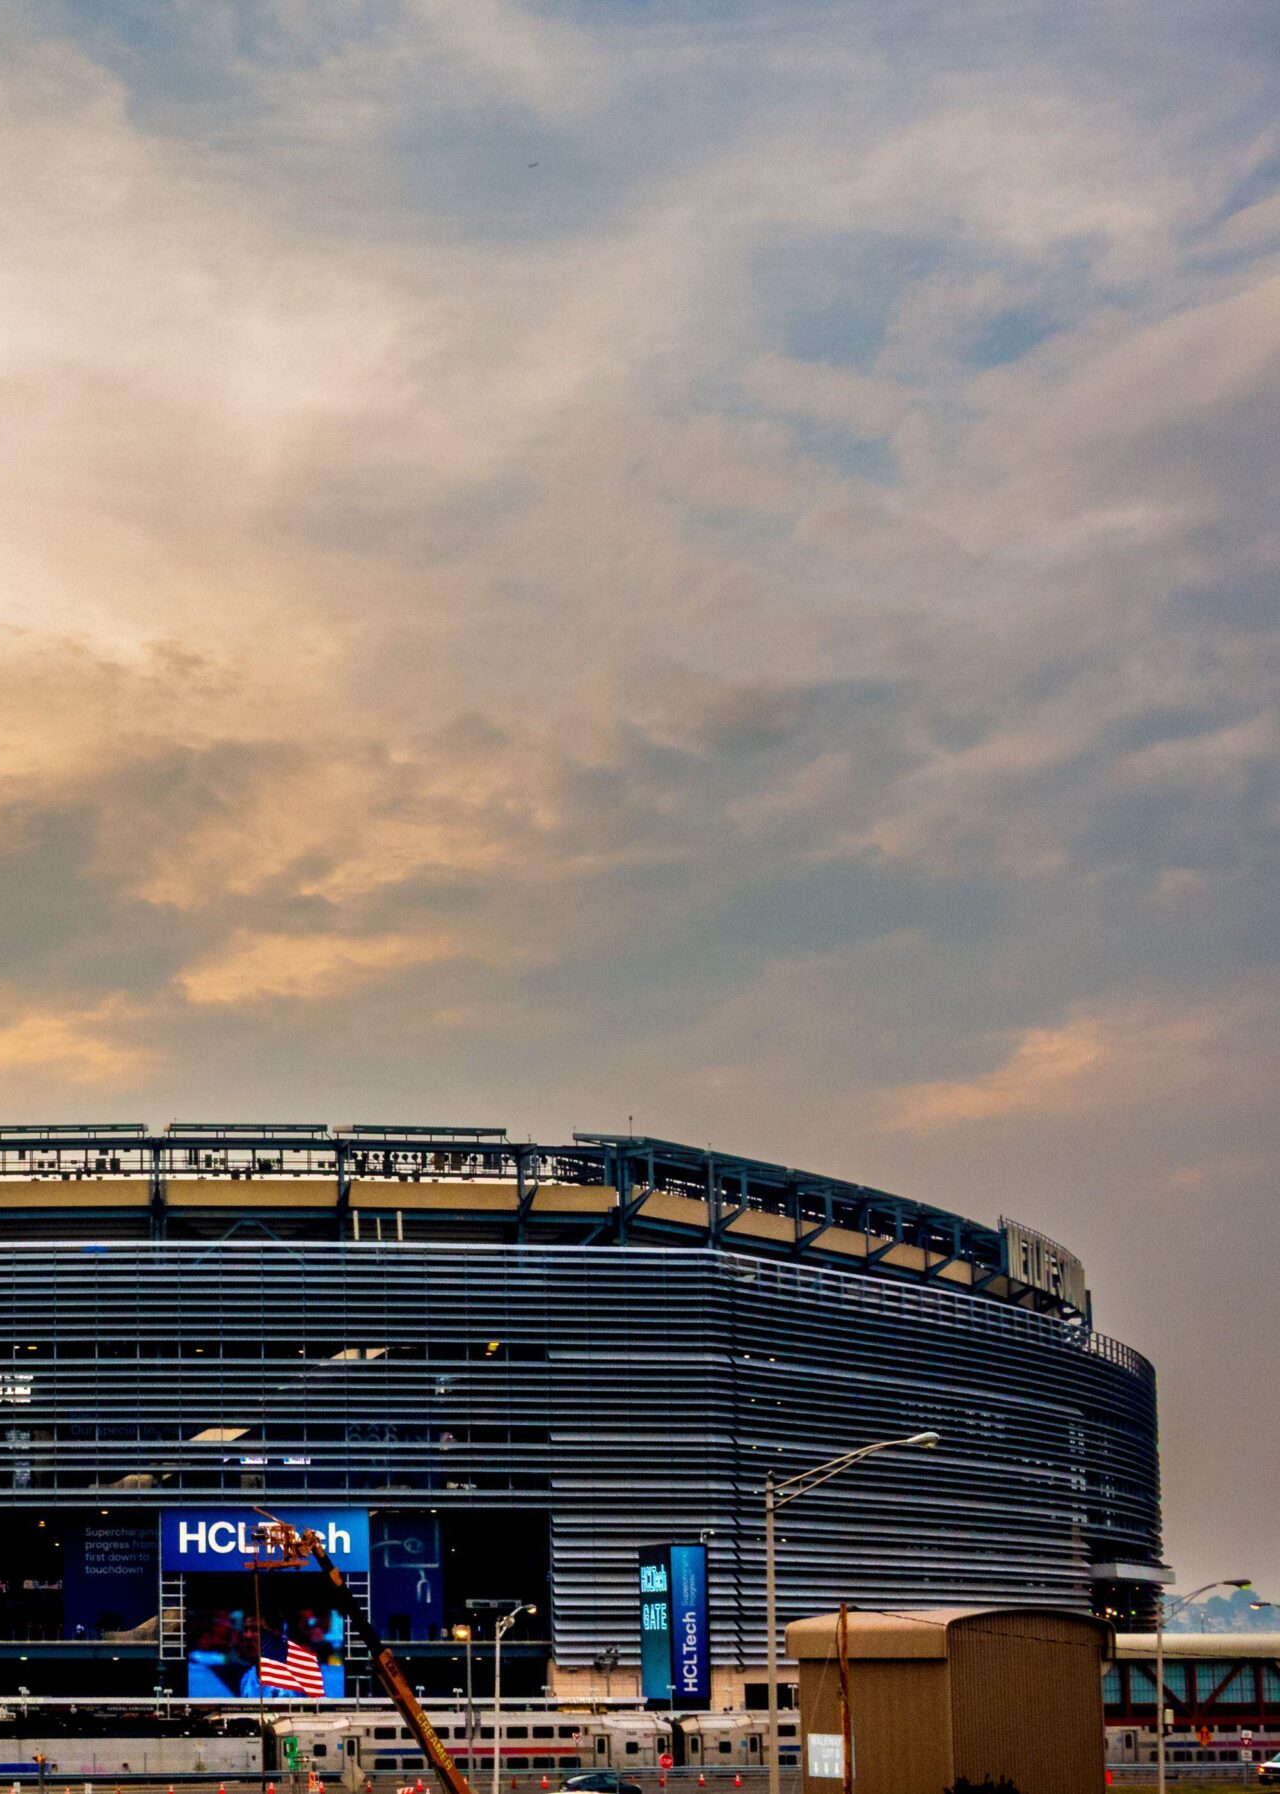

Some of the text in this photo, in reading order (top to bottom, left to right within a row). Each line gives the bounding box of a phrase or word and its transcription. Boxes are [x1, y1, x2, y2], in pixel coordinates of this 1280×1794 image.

[85, 1541, 130, 1552] progress
[85, 1552, 105, 1562] first
[107, 1552, 136, 1562] down
[85, 1565, 144, 1575] touchdown
[643, 1603, 667, 1630] GATE
[682, 1611, 698, 1692] HCLTech
[416, 1712, 454, 1770] CREAMER
